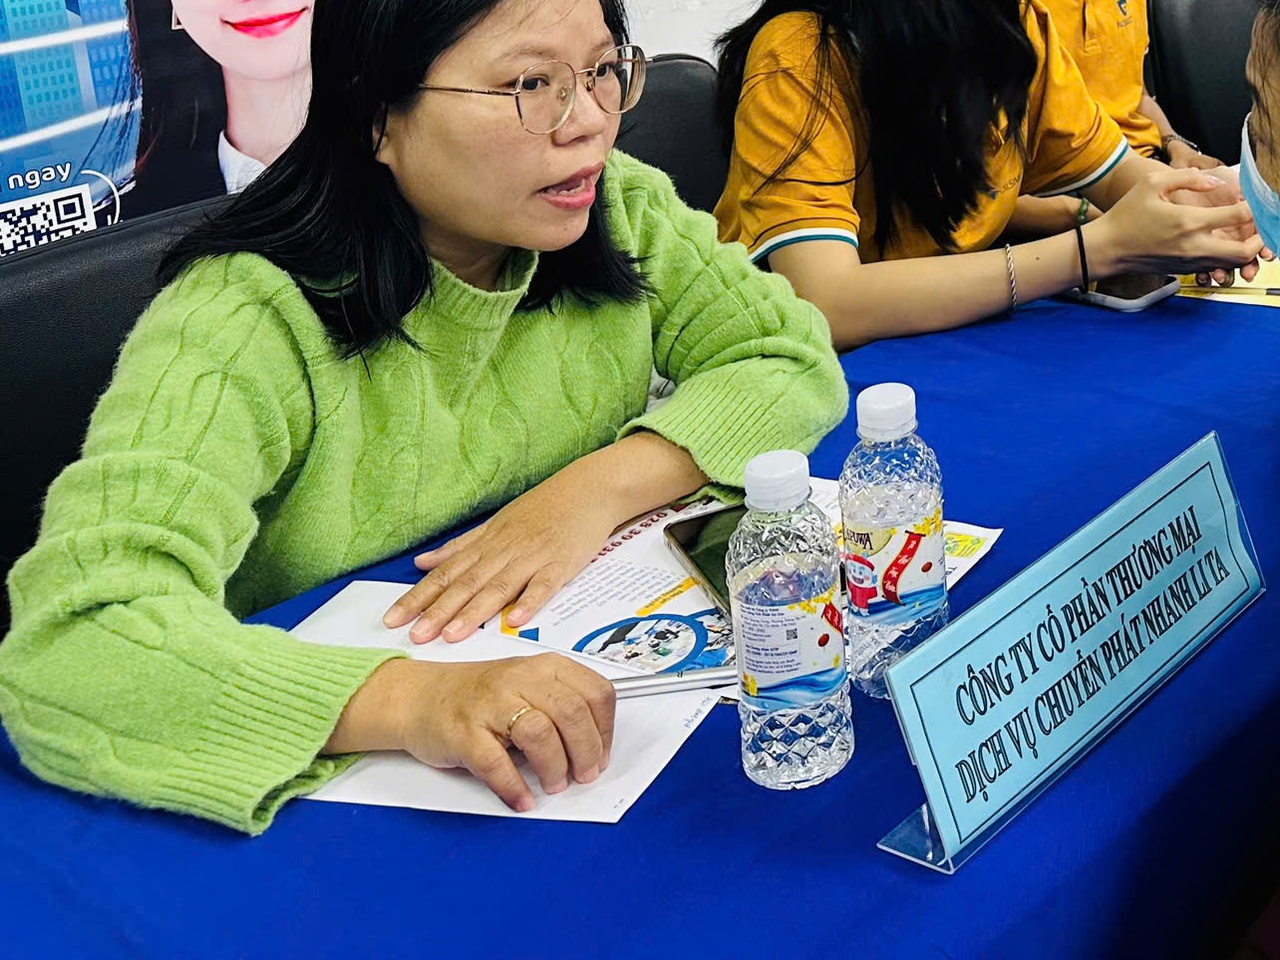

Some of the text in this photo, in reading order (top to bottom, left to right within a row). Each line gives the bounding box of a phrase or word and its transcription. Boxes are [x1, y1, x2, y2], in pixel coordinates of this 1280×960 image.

[8, 162, 71, 189] ngay
[954, 731, 1014, 804] DỊCH
[1003, 707, 1040, 760] VỤ
[1034, 651, 1108, 737] CHUYỂN
[1099, 612, 1146, 681] PHÁT
[1140, 571, 1198, 645] NHANH
[955, 504, 1203, 726] CÔNG TY CỔ PHẦN THƯƠNG MẠI
